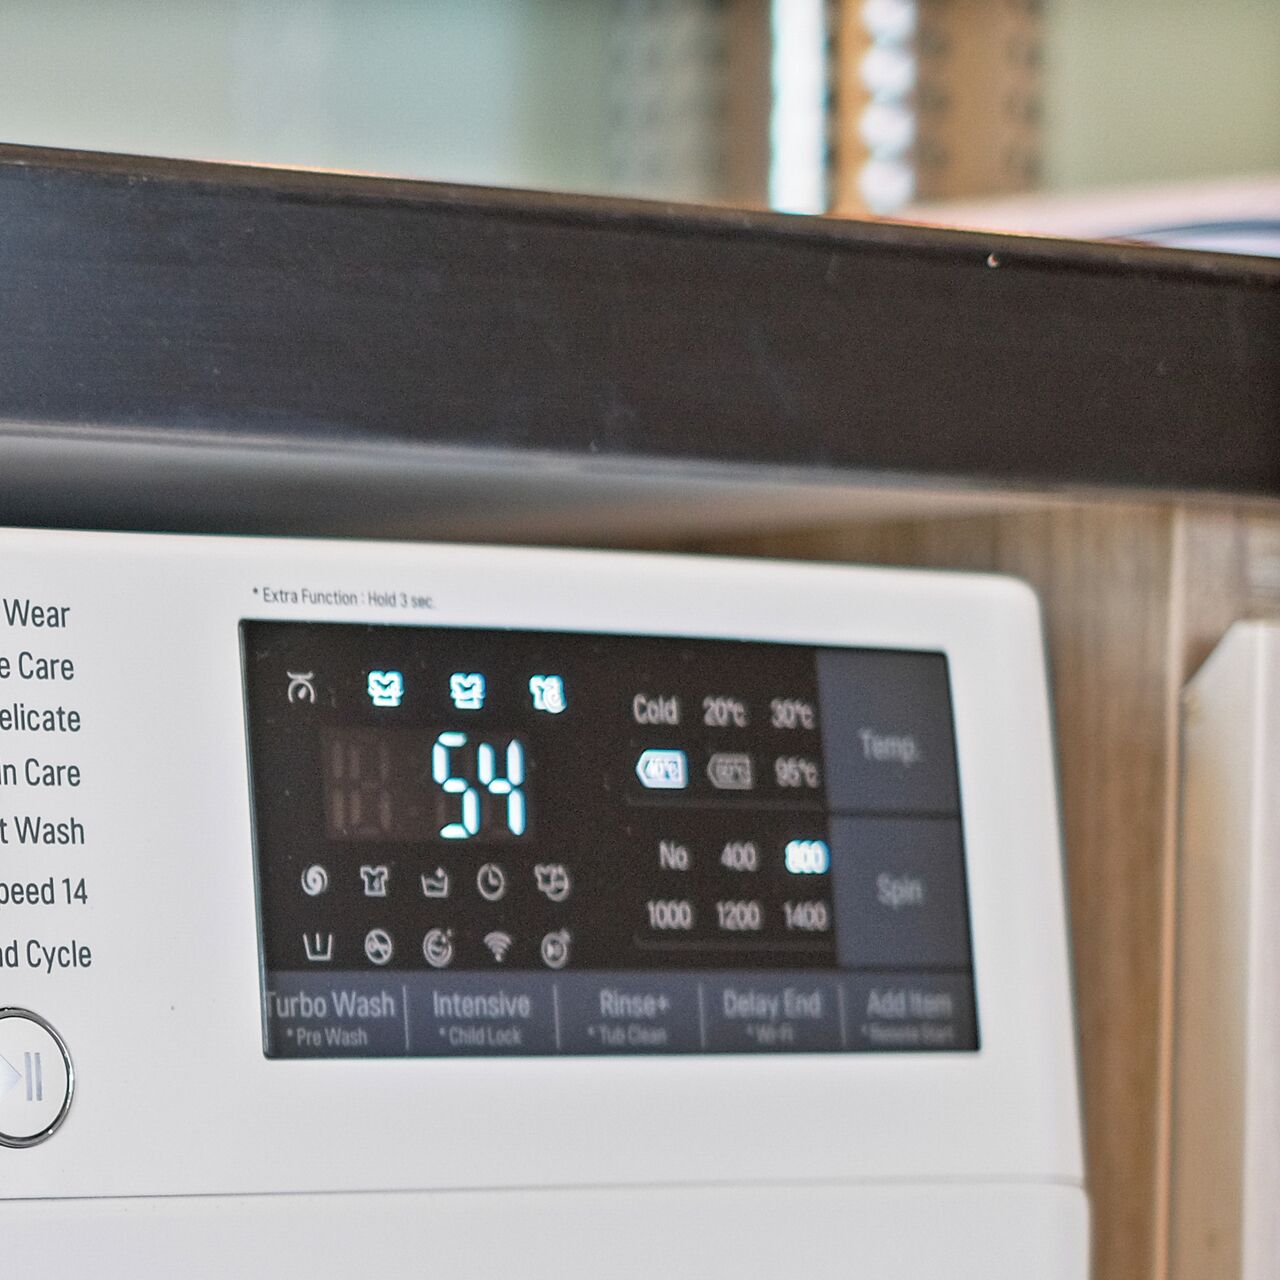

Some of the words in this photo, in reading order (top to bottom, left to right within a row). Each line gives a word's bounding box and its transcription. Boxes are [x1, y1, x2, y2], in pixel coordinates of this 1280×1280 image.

[263, 587, 298, 604] Extra
[301, 588, 358, 607] Function
[368, 592, 397, 608] Hold
[3, 598, 71, 628] Wear
[18, 651, 75, 680] Care
[632, 693, 680, 725] Cold
[24, 757, 81, 787] Care
[431, 730, 527, 840] 54
[14, 816, 85, 845] Wash
[659, 840, 689, 871] No
[721, 842, 759, 872] 400
[61, 877, 88, 904] 14
[875, 873, 924, 908] Spin
[647, 901, 693, 931] 1000
[716, 901, 763, 931] 1200
[783, 902, 830, 932] 1400
[26, 939, 93, 973] Cycle
[331, 991, 395, 1018] Wash
[432, 990, 532, 1019] Intensive
[722, 988, 780, 1021] Delay
[784, 988, 823, 1018] End
[866, 987, 908, 1018] Add
[296, 1028, 322, 1047] Pre
[325, 1027, 368, 1047] Wash
[449, 1027, 484, 1047] Child
[487, 1027, 522, 1047] Lock
